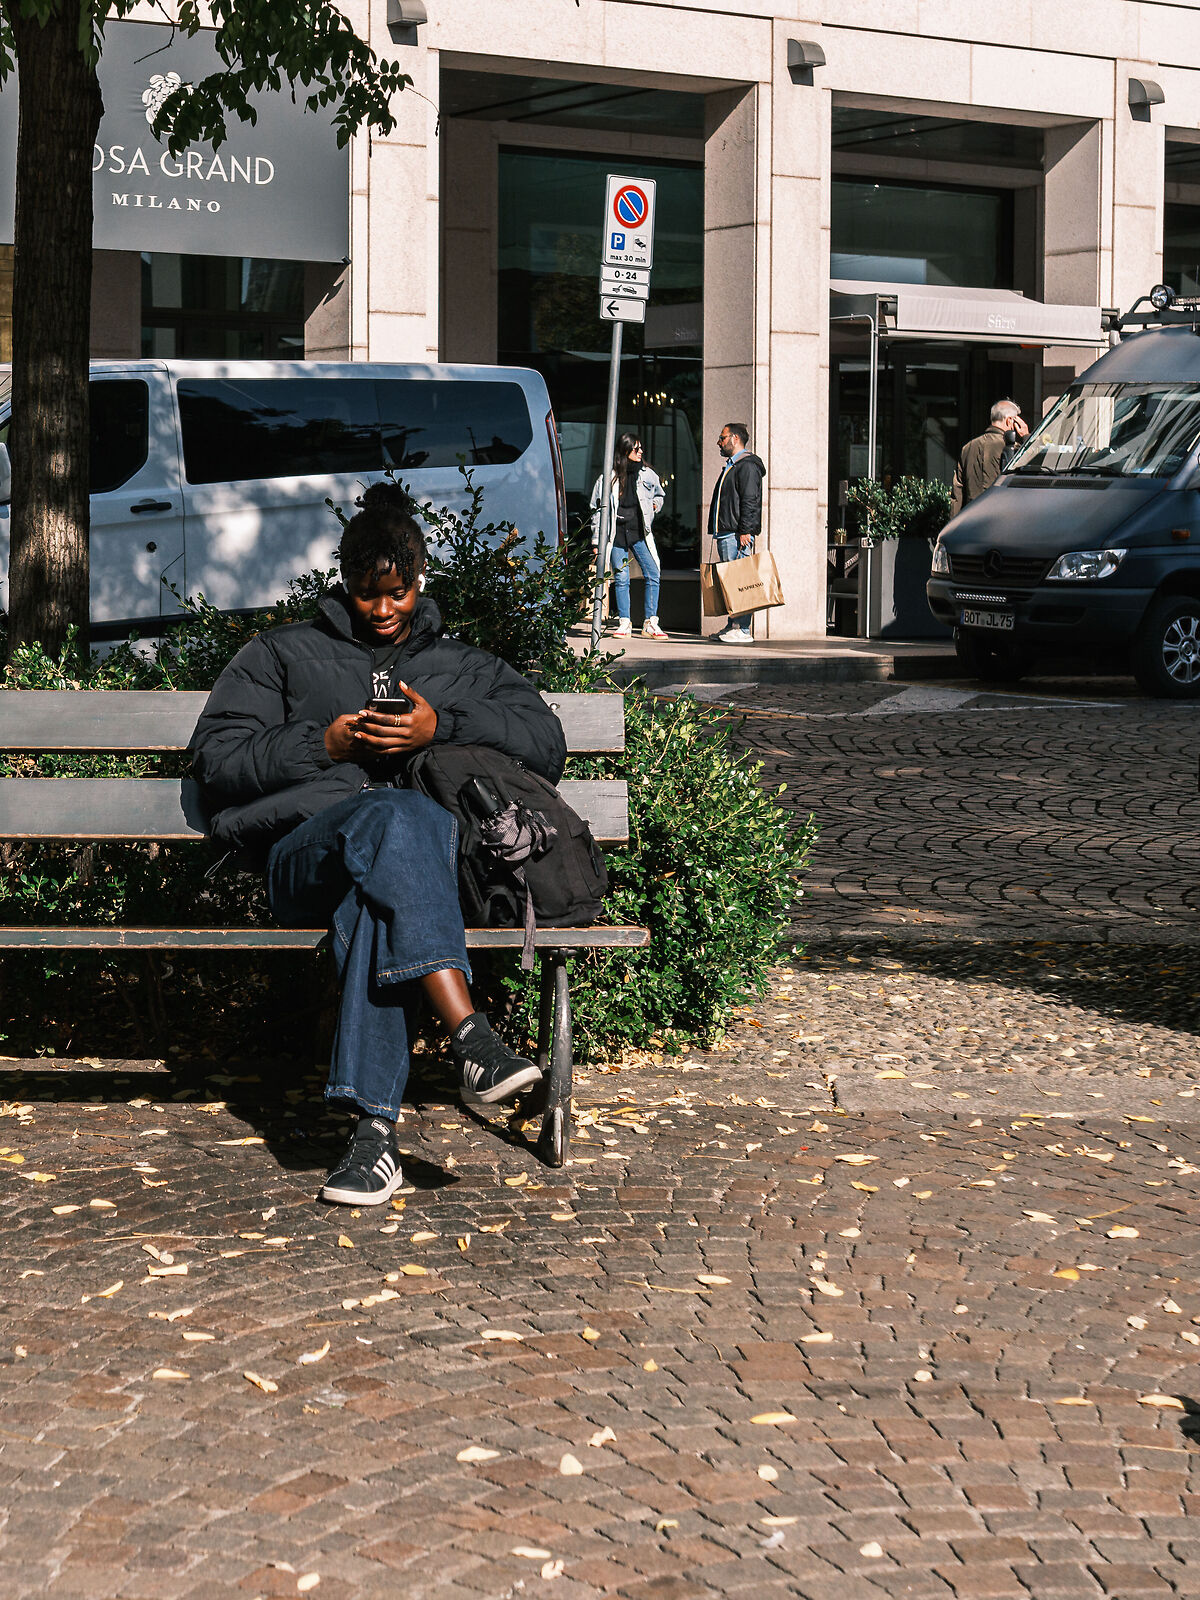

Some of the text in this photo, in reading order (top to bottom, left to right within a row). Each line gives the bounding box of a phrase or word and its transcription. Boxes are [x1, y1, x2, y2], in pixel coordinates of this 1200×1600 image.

[92, 143, 275, 185] OSA GRAND
[112, 192, 221, 213] MILANO
[614, 235, 623, 248] P
